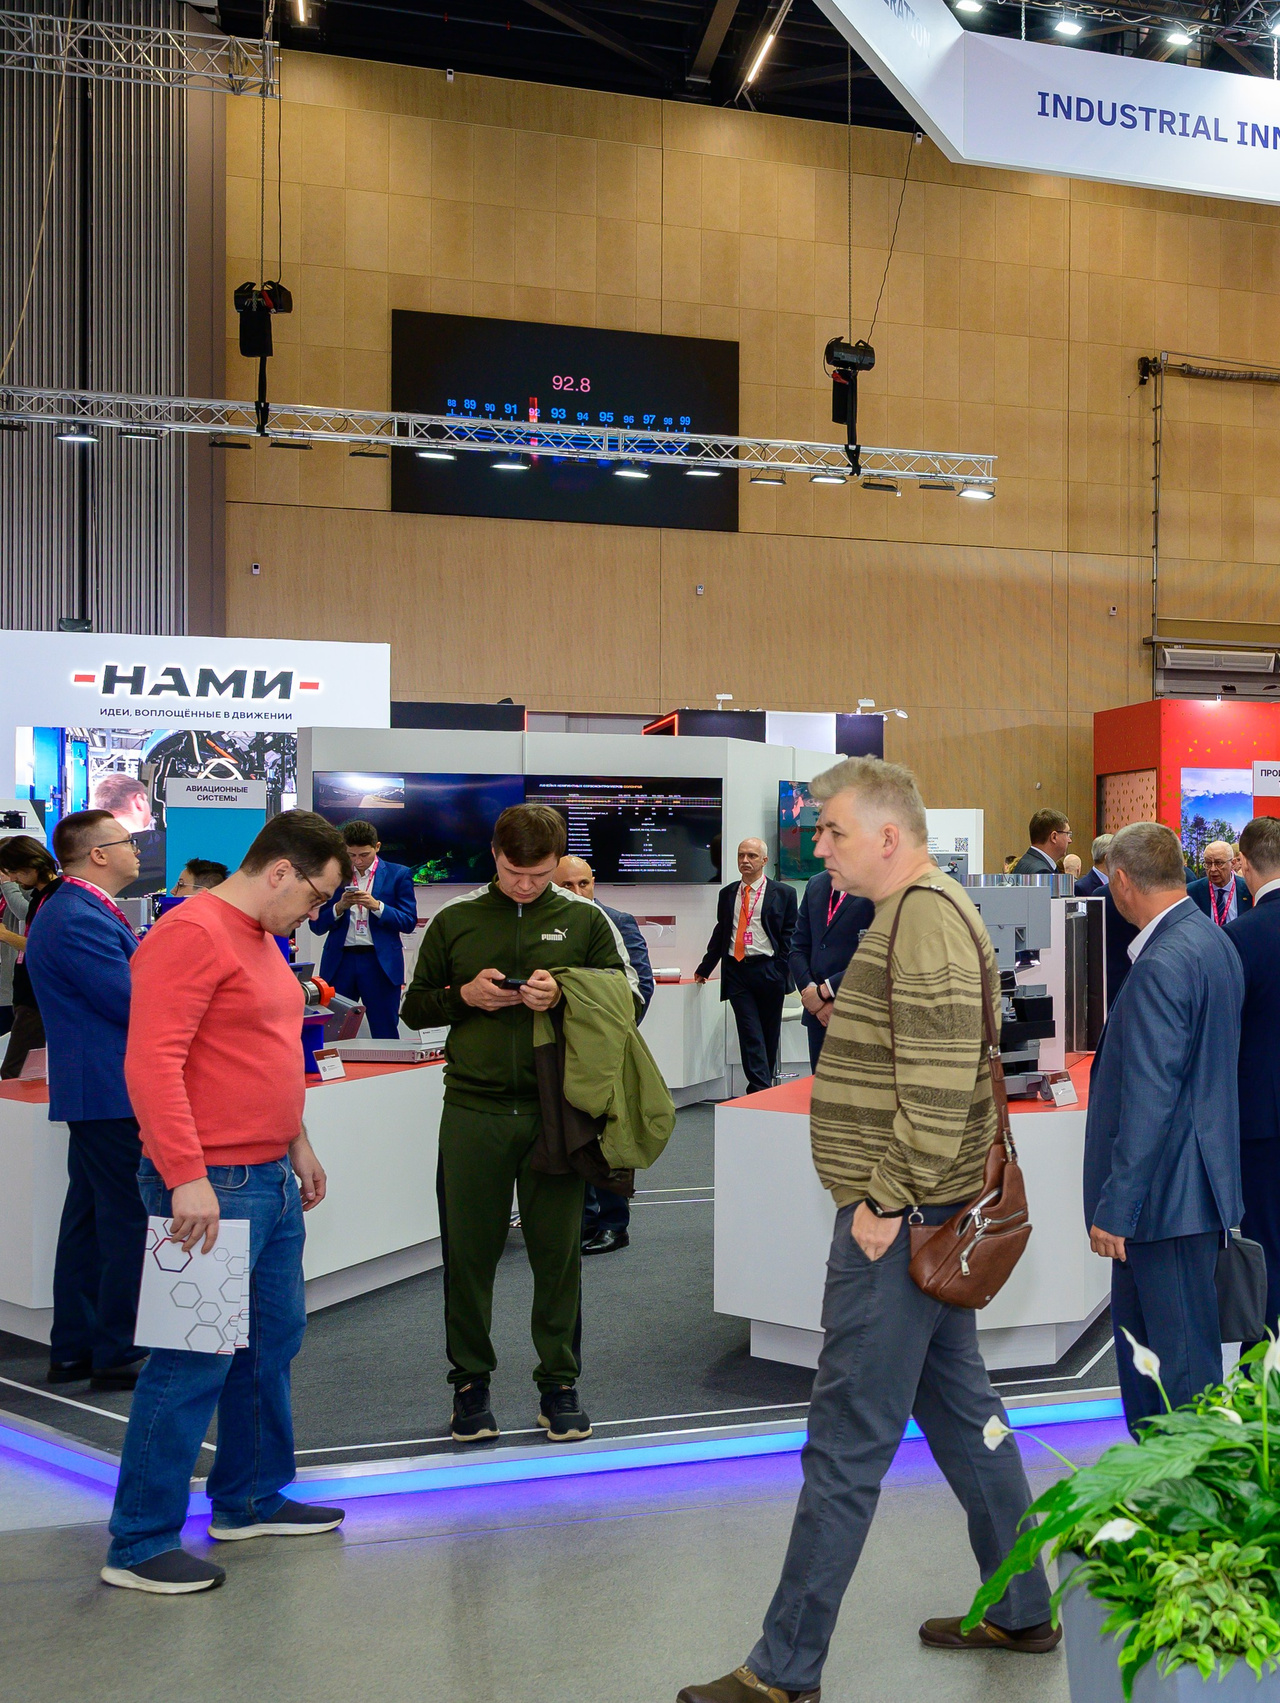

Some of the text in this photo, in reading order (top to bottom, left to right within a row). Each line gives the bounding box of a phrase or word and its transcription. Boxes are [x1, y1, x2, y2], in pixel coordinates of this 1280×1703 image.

[1037, 91, 1228, 143] INDUSTRIAL
[552, 375, 591, 393] 92.8
[464, 399, 477, 410] 89
[484, 403, 496, 412] 90
[504, 404, 518, 415] 91
[529, 408, 540, 417] 92
[551, 408, 566, 420] 93
[576, 412, 589, 421] 94
[599, 412, 614, 423] 95
[623, 415, 634, 424] 96
[643, 414, 656, 425] 97
[680, 416, 691, 426] 99
[101, 665, 293, 699] НАМИ
[100, 707, 292, 720] ИДЕИ, ВОПЛОЩЁННЫЕ В ДВИЖЕНИИ
[186, 785, 248, 794] АВИАЦИОННЫЕ
[196, 794, 238, 802] СИСТЕМЫ
